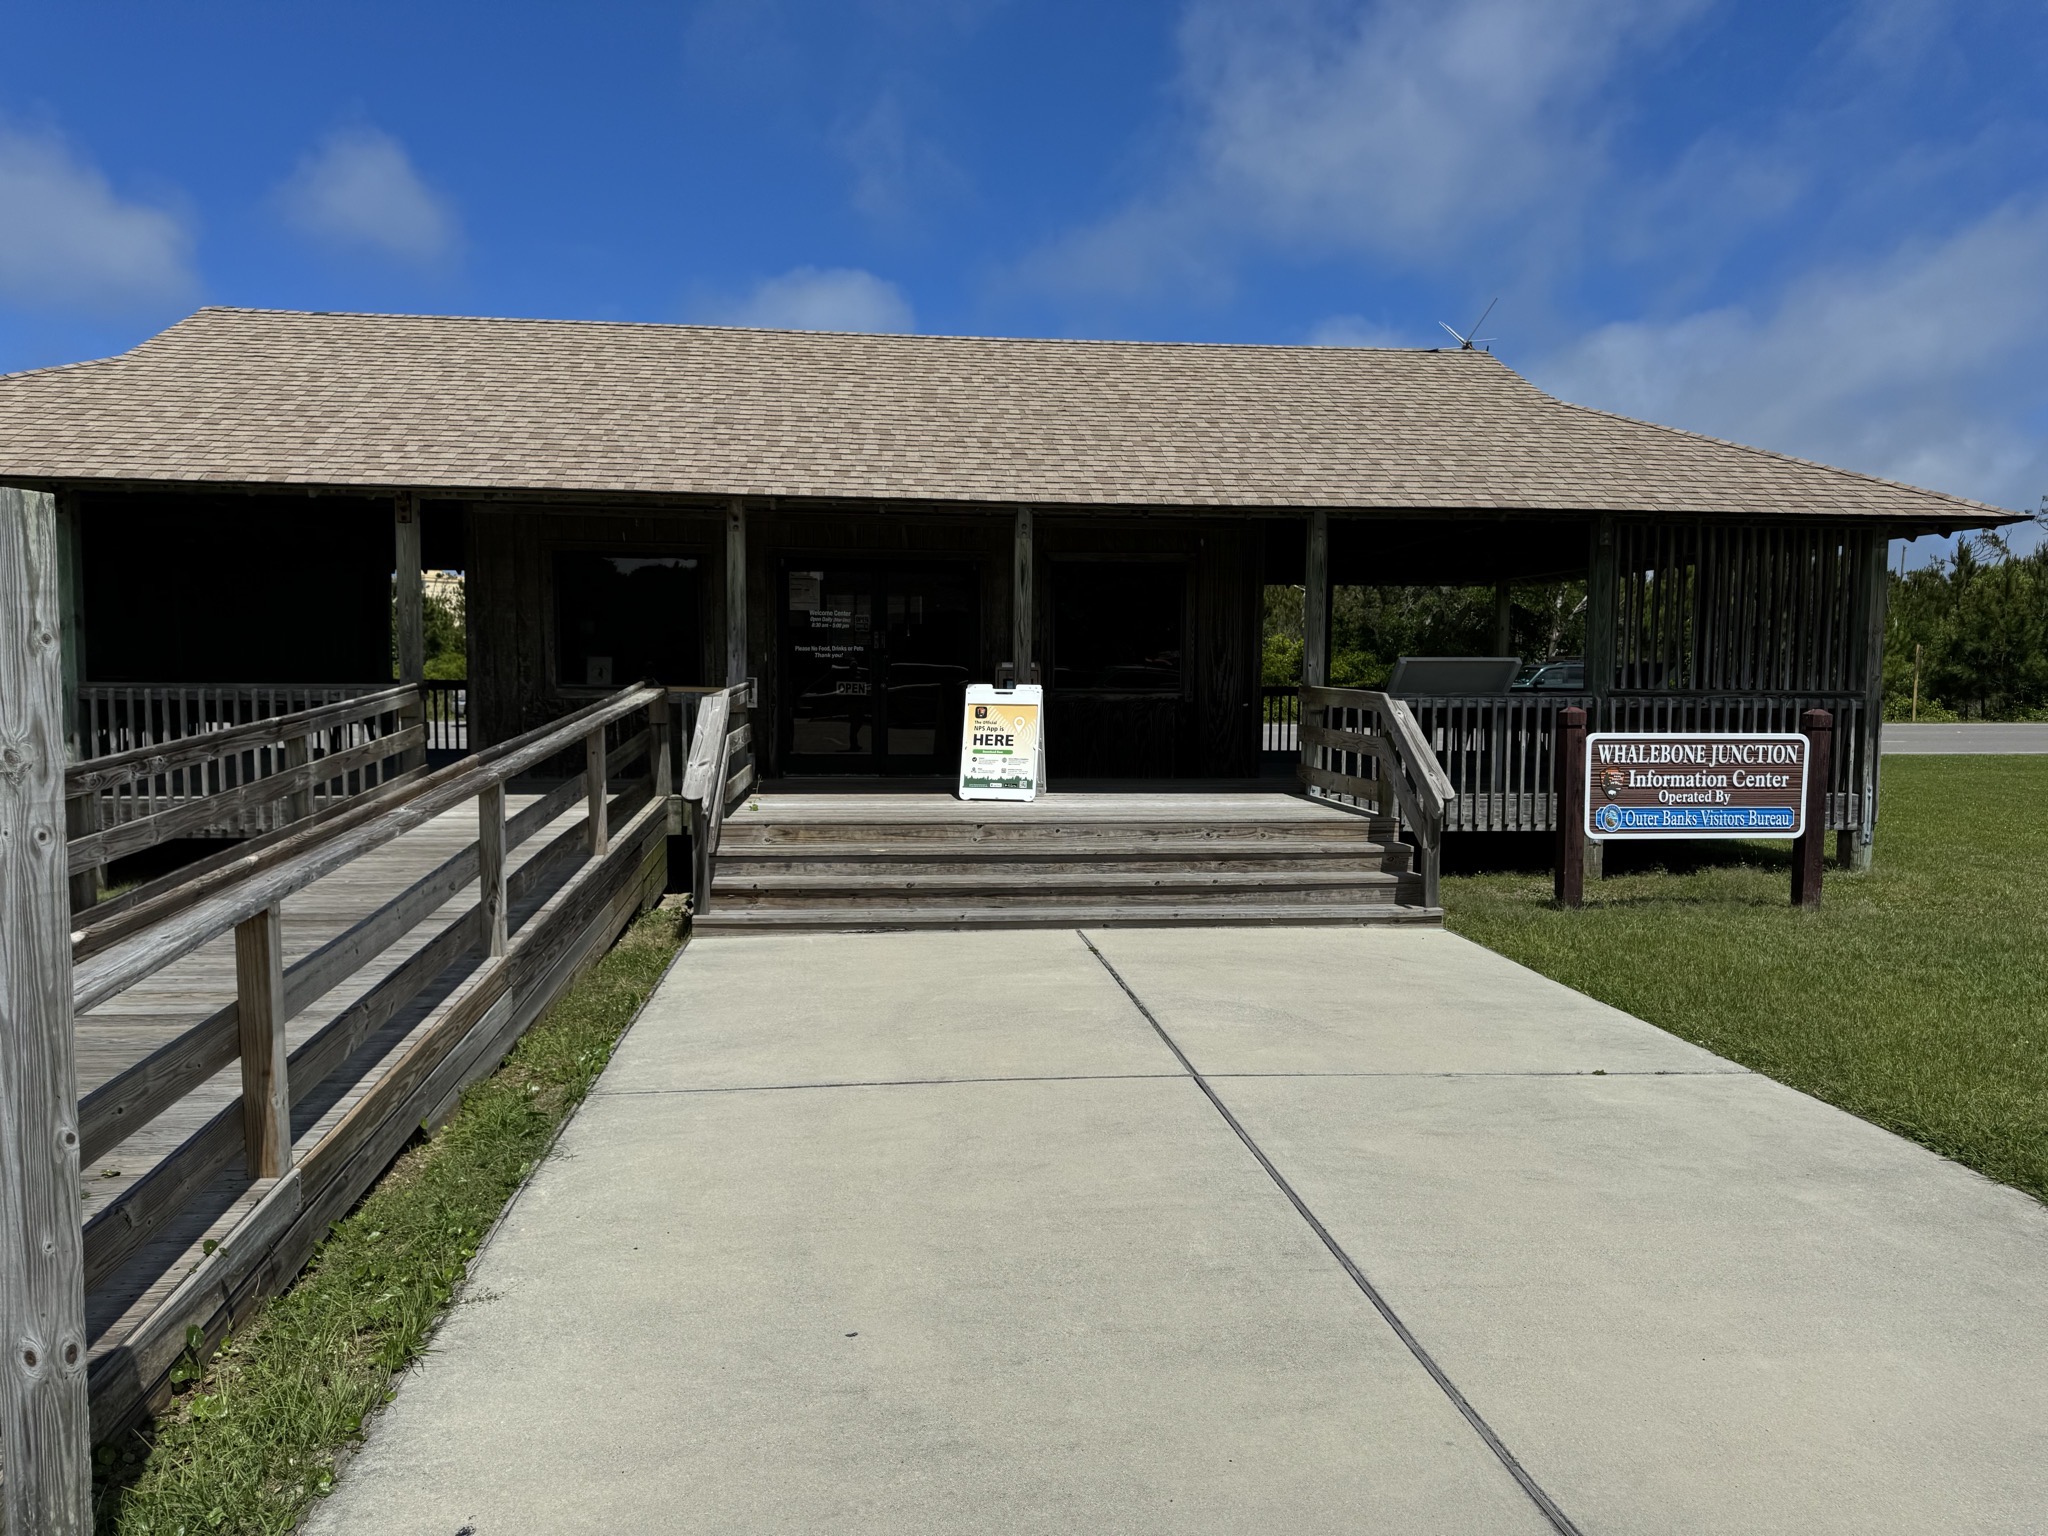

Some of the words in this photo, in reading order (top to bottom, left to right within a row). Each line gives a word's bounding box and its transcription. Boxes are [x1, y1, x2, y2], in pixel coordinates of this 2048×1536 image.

[838, 683, 865, 693] OPEN
[973, 734, 1014, 746] HERE
[1598, 744, 1707, 764] WHALEBONE
[1708, 744, 1799, 768] JUNCTION
[1628, 769, 1728, 789] Information
[1732, 769, 1790, 788] Center
[1658, 789, 1712, 806] Operated
[1715, 790, 1731, 806] By
[1625, 810, 1660, 827] Outer
[1662, 810, 1697, 827] Banks
[1700, 809, 1745, 827] Visitors
[1748, 810, 1789, 827] Bureau
